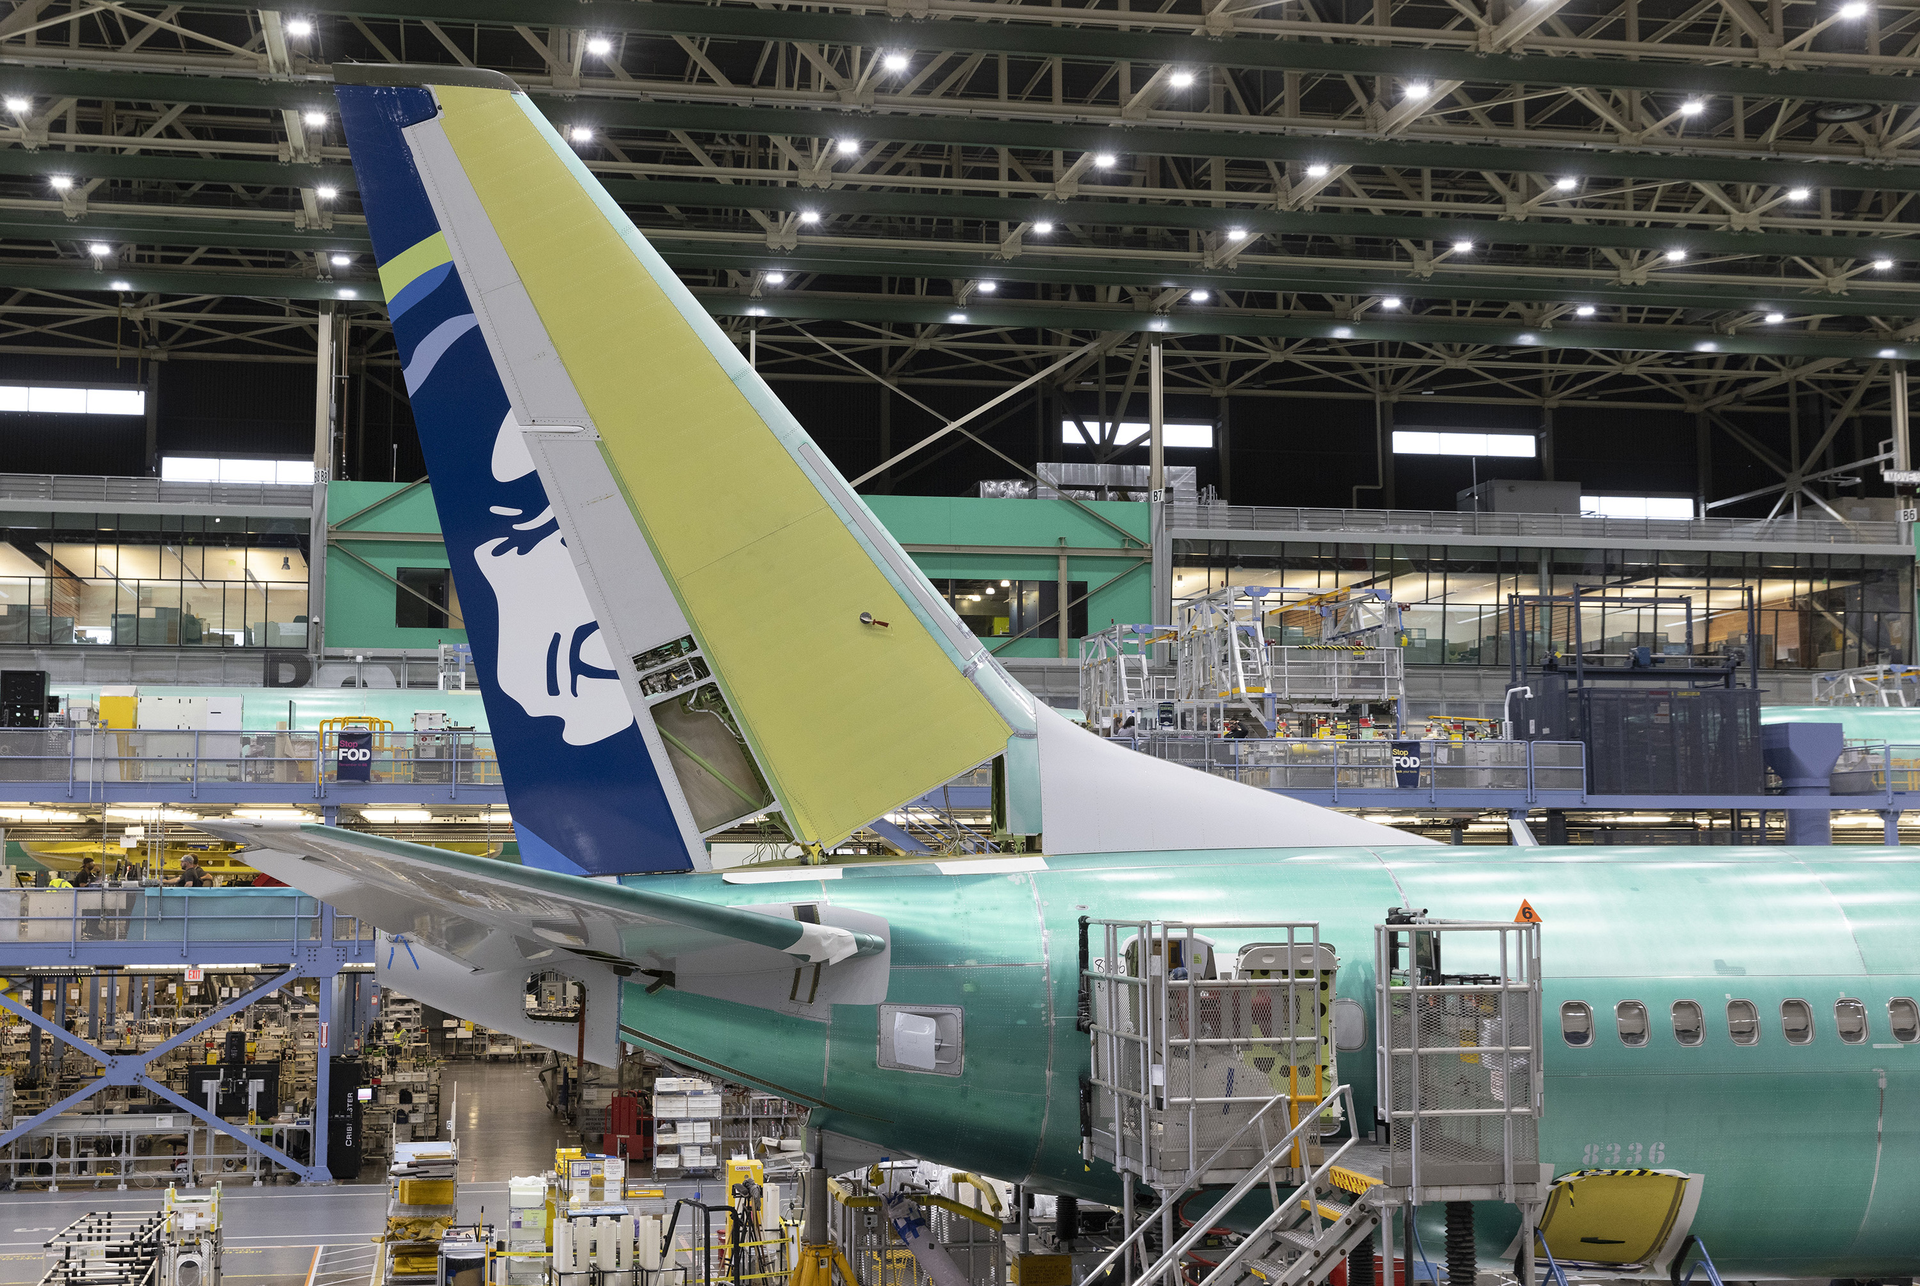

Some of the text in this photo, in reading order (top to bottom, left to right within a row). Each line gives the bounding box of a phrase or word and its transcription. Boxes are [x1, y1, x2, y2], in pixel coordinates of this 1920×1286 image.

[1153, 490, 1162, 502] B7
[1903, 510, 1915, 521] B6
[339, 740, 358, 749] Stop
[338, 748, 370, 760] FOD
[1392, 748, 1408, 757] Stop
[1392, 756, 1420, 768] FOD
[1522, 907, 1533, 920] 6
[1094, 958, 1126, 974] 86
[188, 970, 201, 980] EXIT
[1582, 1141, 1666, 1166] 8336
